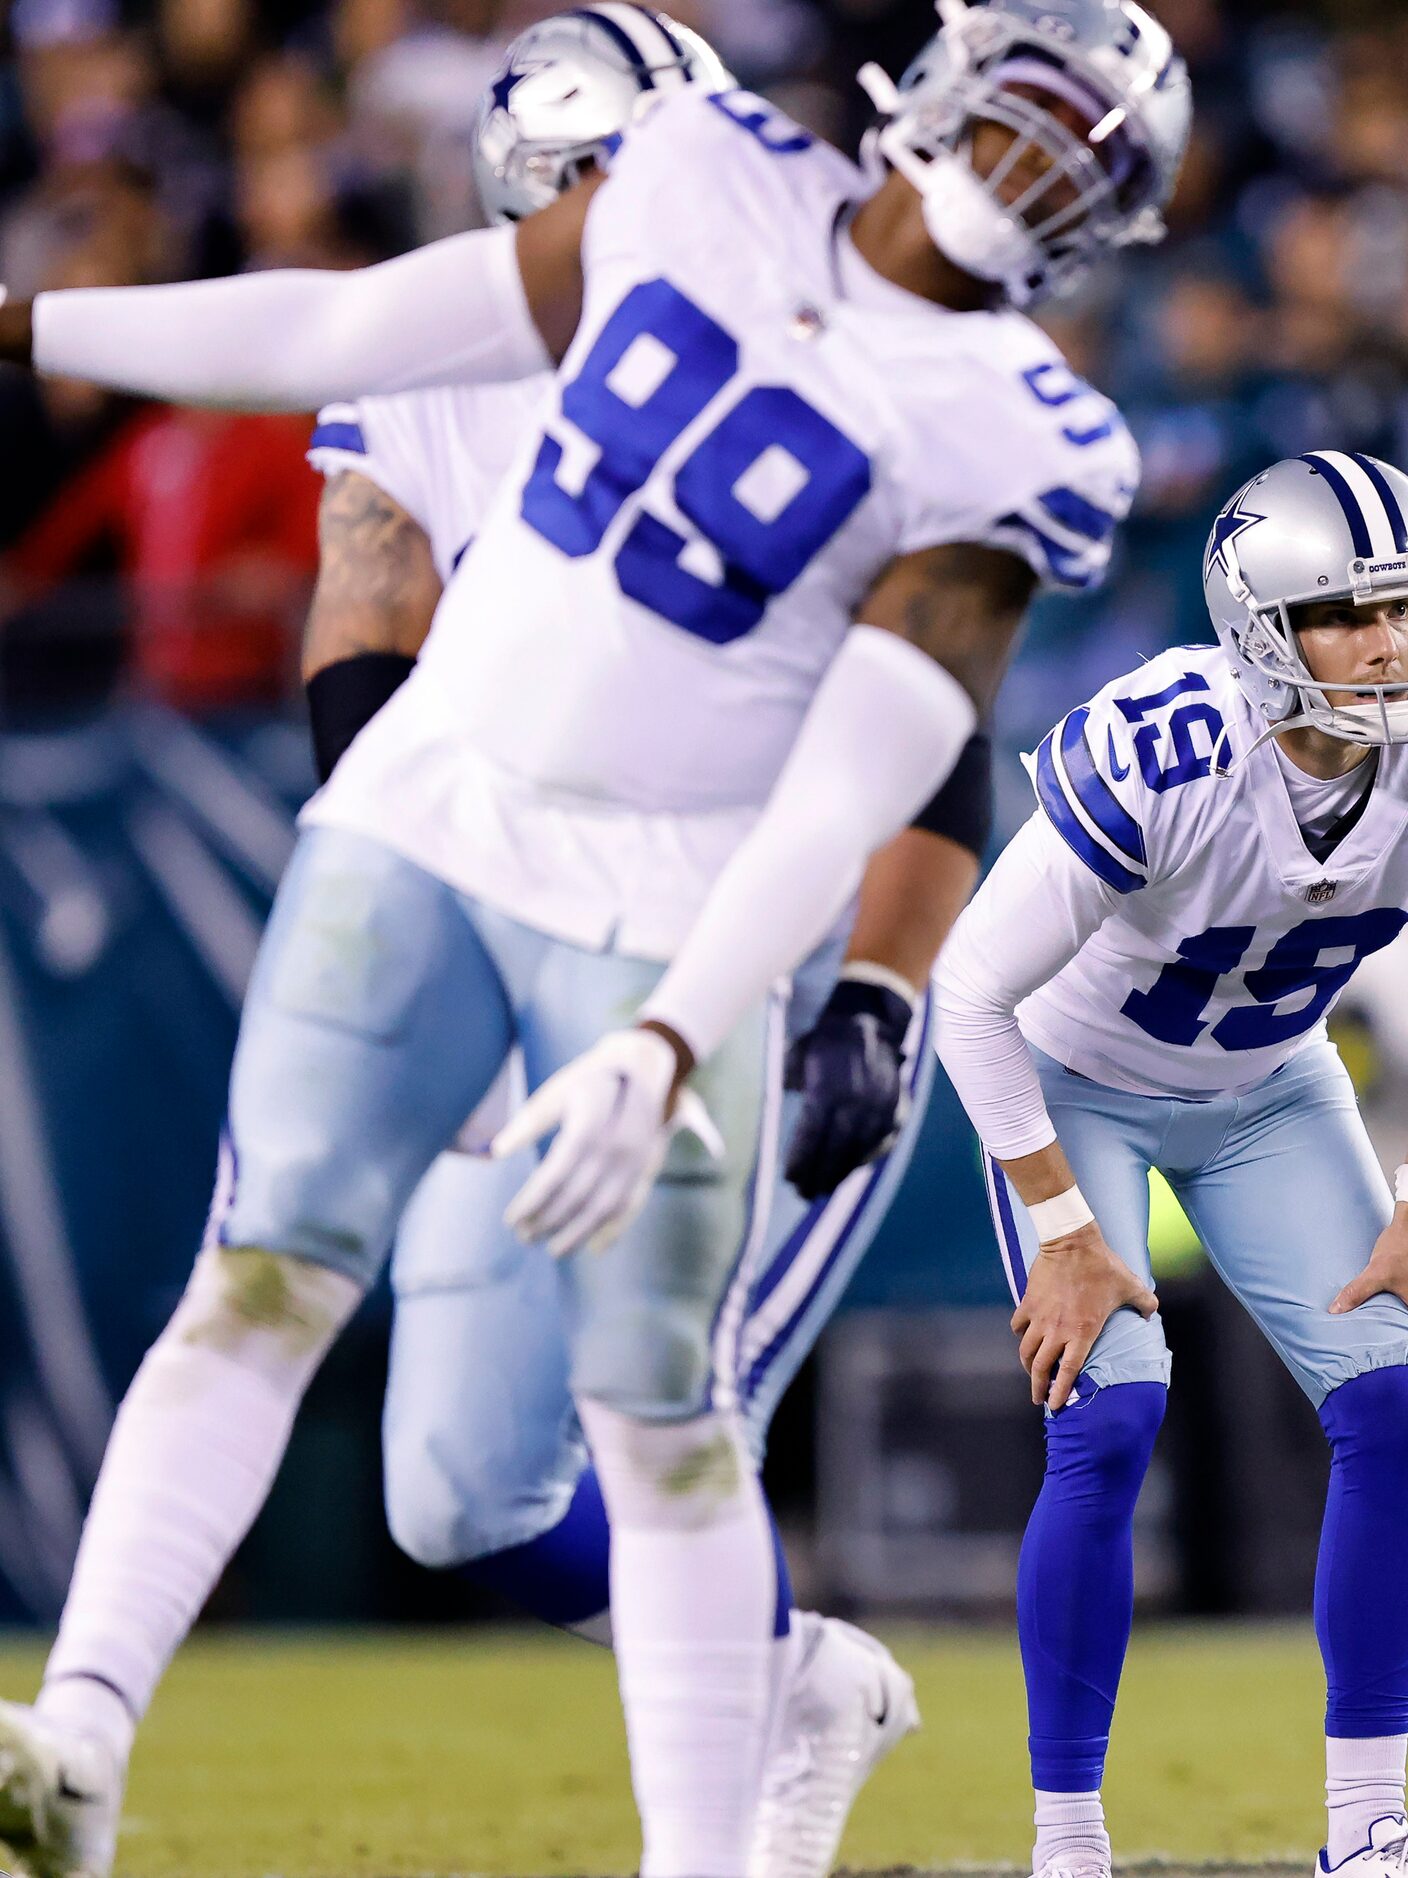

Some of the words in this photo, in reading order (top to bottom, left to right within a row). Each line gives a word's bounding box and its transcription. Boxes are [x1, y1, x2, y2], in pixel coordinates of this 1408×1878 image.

[521, 277, 871, 645] 99
[1369, 561, 1406, 573] COWBOYS
[1112, 672, 1233, 795] 19
[1310, 891, 1331, 901] NFL
